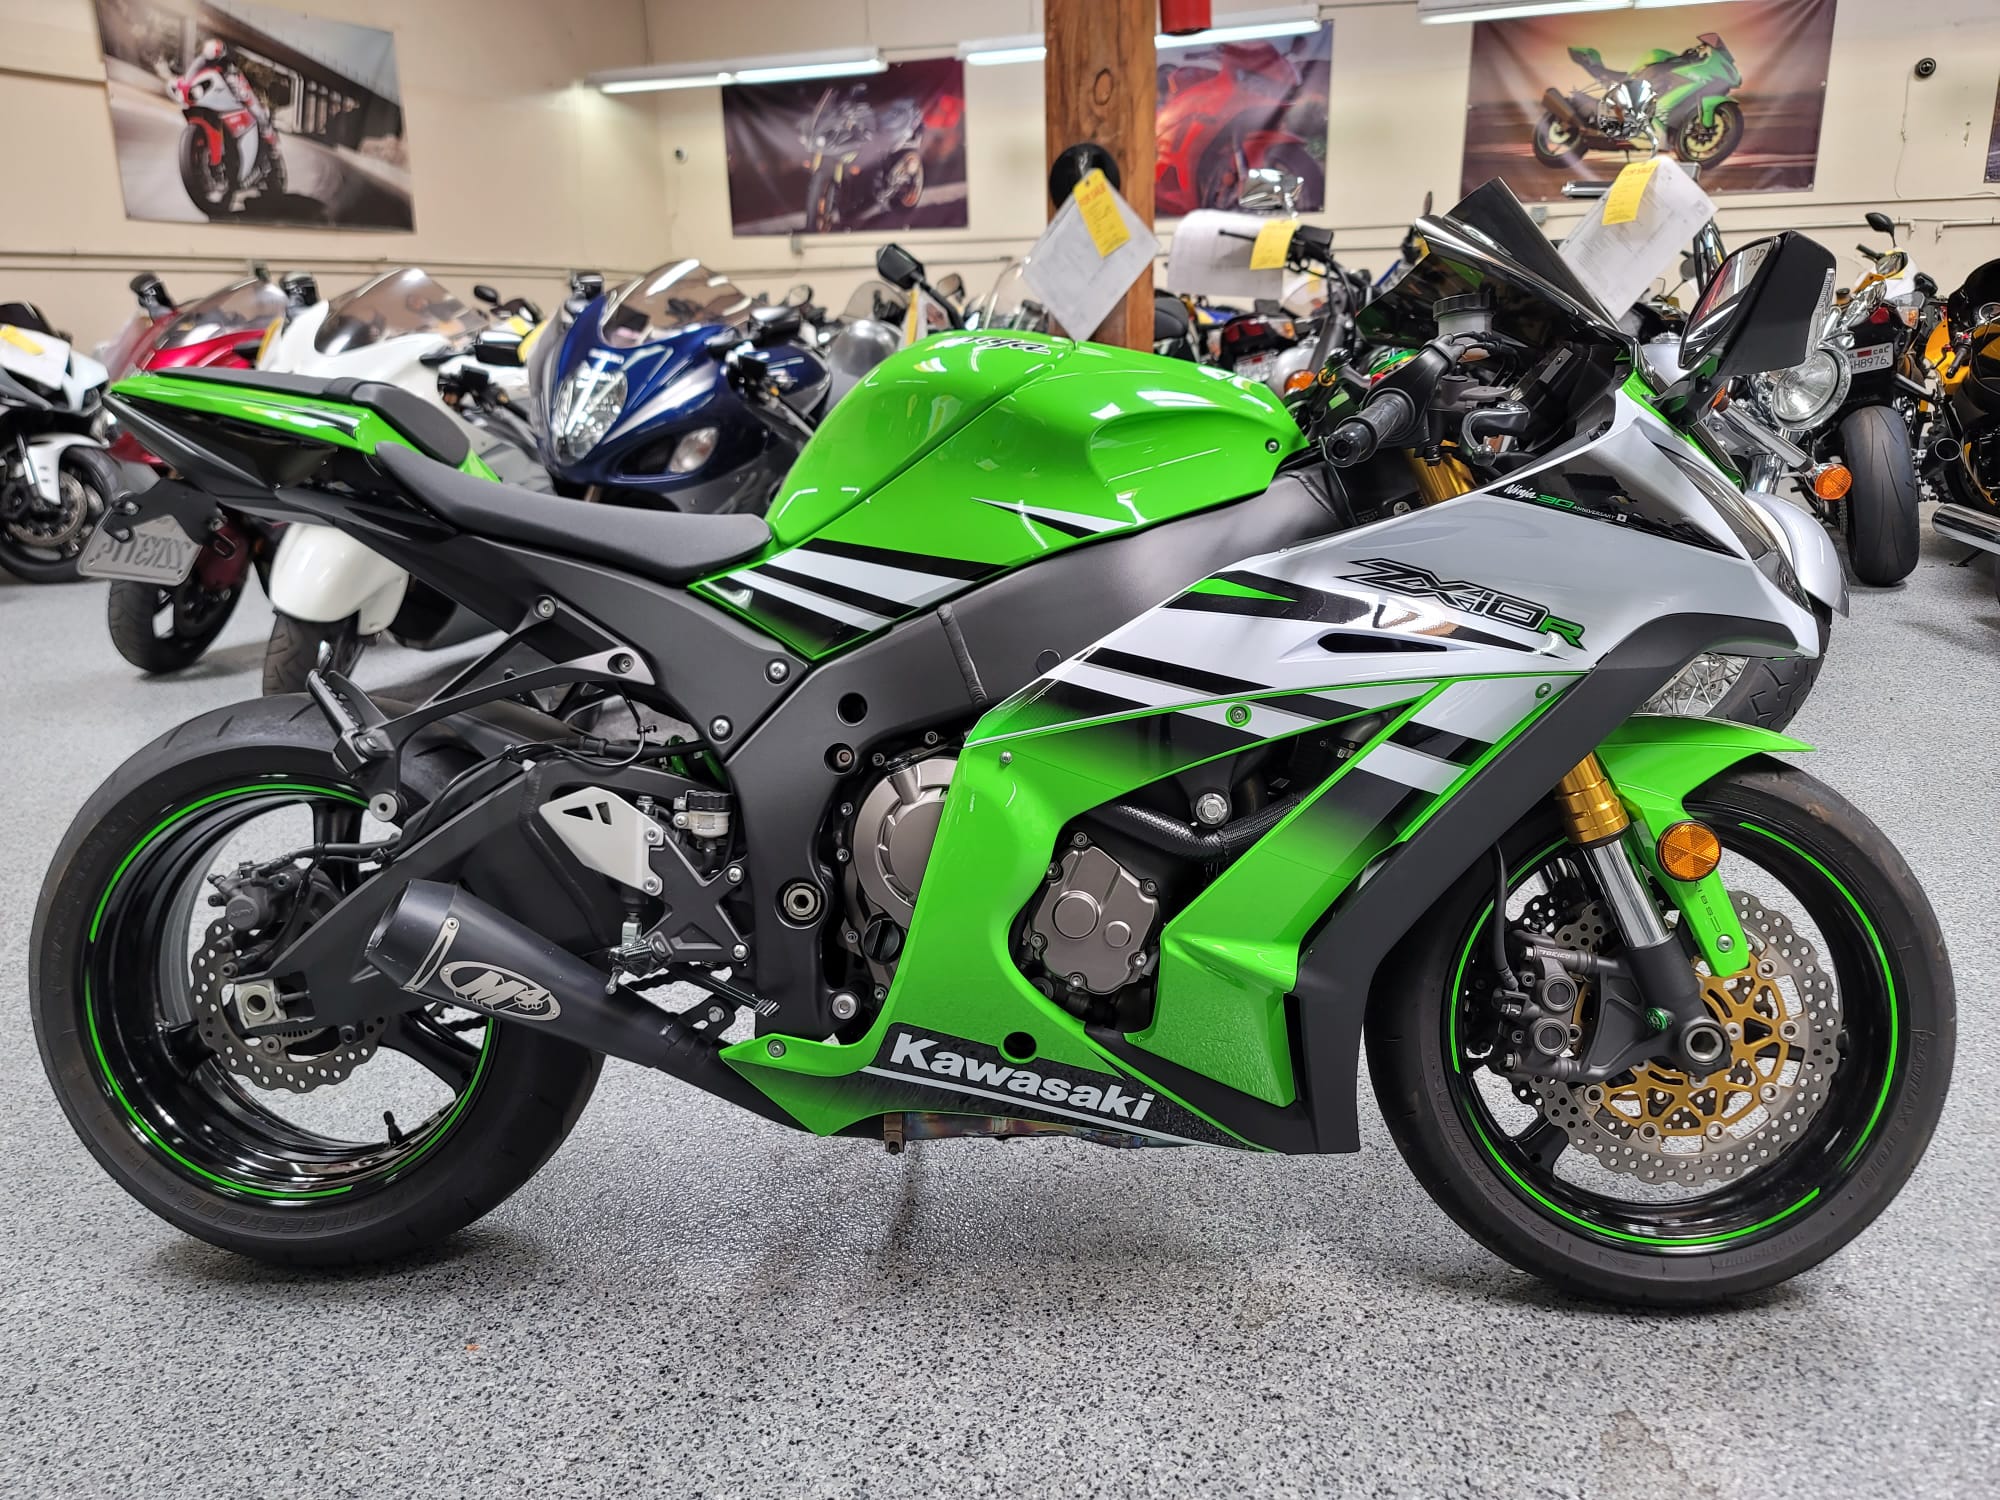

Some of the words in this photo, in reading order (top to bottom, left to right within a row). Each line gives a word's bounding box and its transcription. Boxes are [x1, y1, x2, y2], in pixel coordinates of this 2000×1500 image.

[1504, 483, 1537, 499] Ninja
[1536, 494, 1575, 508] 30
[1573, 505, 1616, 520] ANNIVERSARY
[453, 970, 550, 1012] M4
[890, 1032, 1155, 1131] Kawasaki
[179, 1191, 404, 1234] RIDGESTONE
